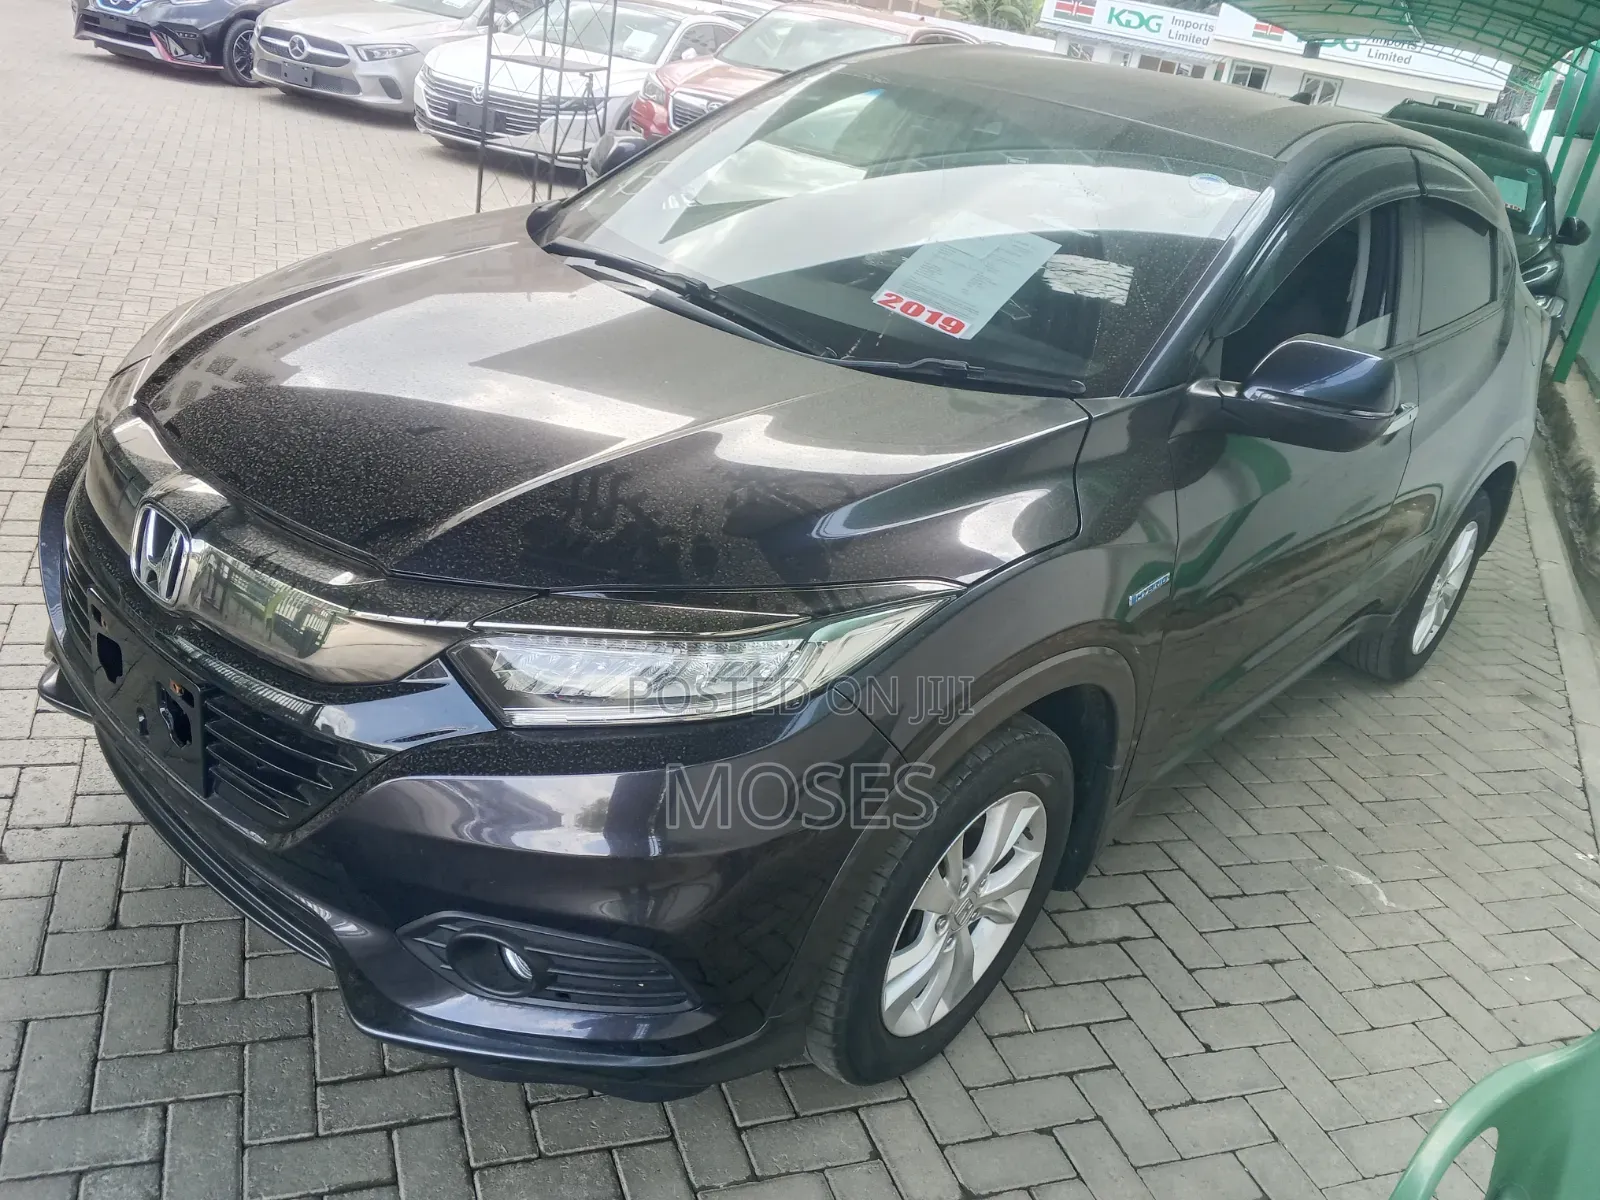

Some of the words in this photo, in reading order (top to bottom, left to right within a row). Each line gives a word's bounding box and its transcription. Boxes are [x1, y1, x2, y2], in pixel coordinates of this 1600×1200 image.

[1107, 7, 1164, 33] KDG
[1171, 16, 1215, 33] Imports
[1168, 29, 1210, 46] Limited
[1367, 48, 1413, 65] Limited
[877, 292, 966, 335] 2019
